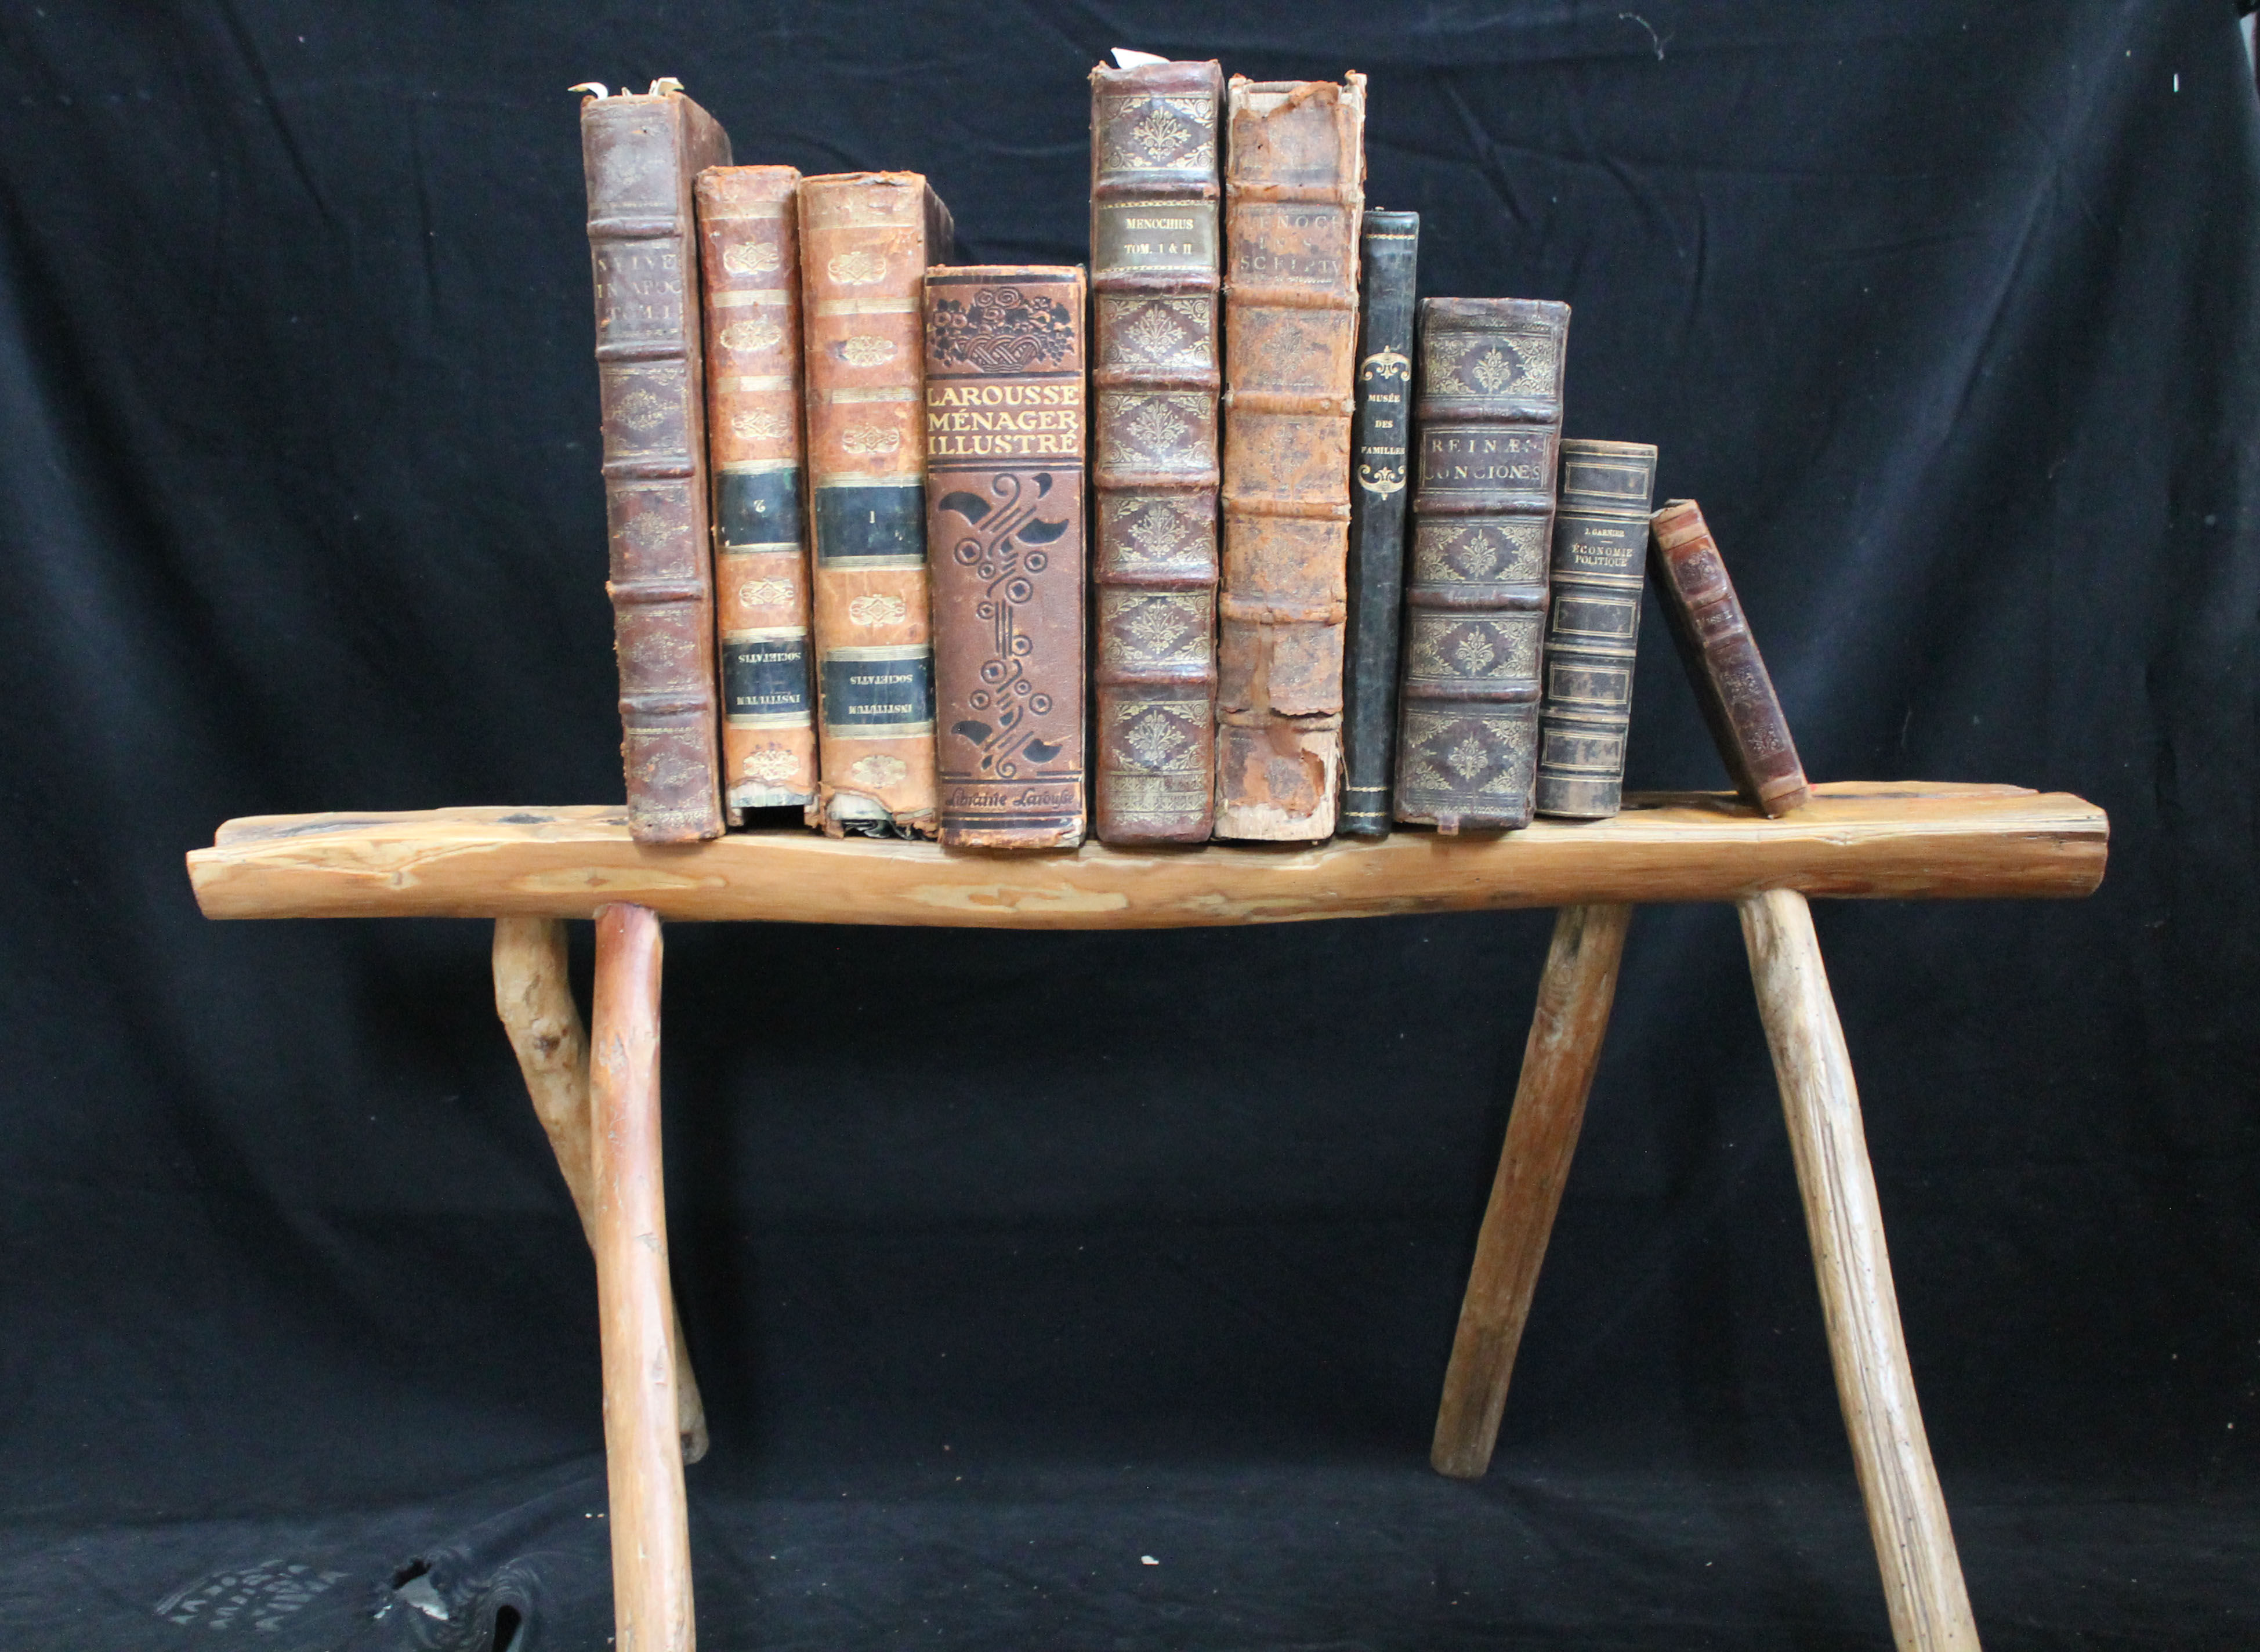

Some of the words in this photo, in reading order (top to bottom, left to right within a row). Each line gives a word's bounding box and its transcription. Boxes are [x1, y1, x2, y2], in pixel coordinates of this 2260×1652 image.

[1125, 218, 1194, 230] MENOCHIUS
[1124, 244, 1153, 254] TOM.
[1169, 243, 1178, 253] &
[1183, 244, 1192, 254] II
[928, 385, 1080, 407] LAROUSSE
[1368, 393, 1401, 403] MUSÉE
[928, 408, 1080, 432] MÉNAGER
[1375, 420, 1393, 429] DES
[928, 429, 1079, 455] ILLUSTRÉ
[1361, 447, 1406, 455] FAMILLES
[754, 499, 766, 513] 2
[1592, 529, 1625, 538] GARNIER
[1571, 543, 1634, 557] ÉCONOMIE
[1574, 555, 1629, 567] POLITIQUE
[738, 653, 802, 663] SOCIETATIS
[849, 674, 913, 685] SOCIETATIS
[737, 694, 801, 705] INSTITUTUM
[849, 704, 912, 714] INSTITUTUM
